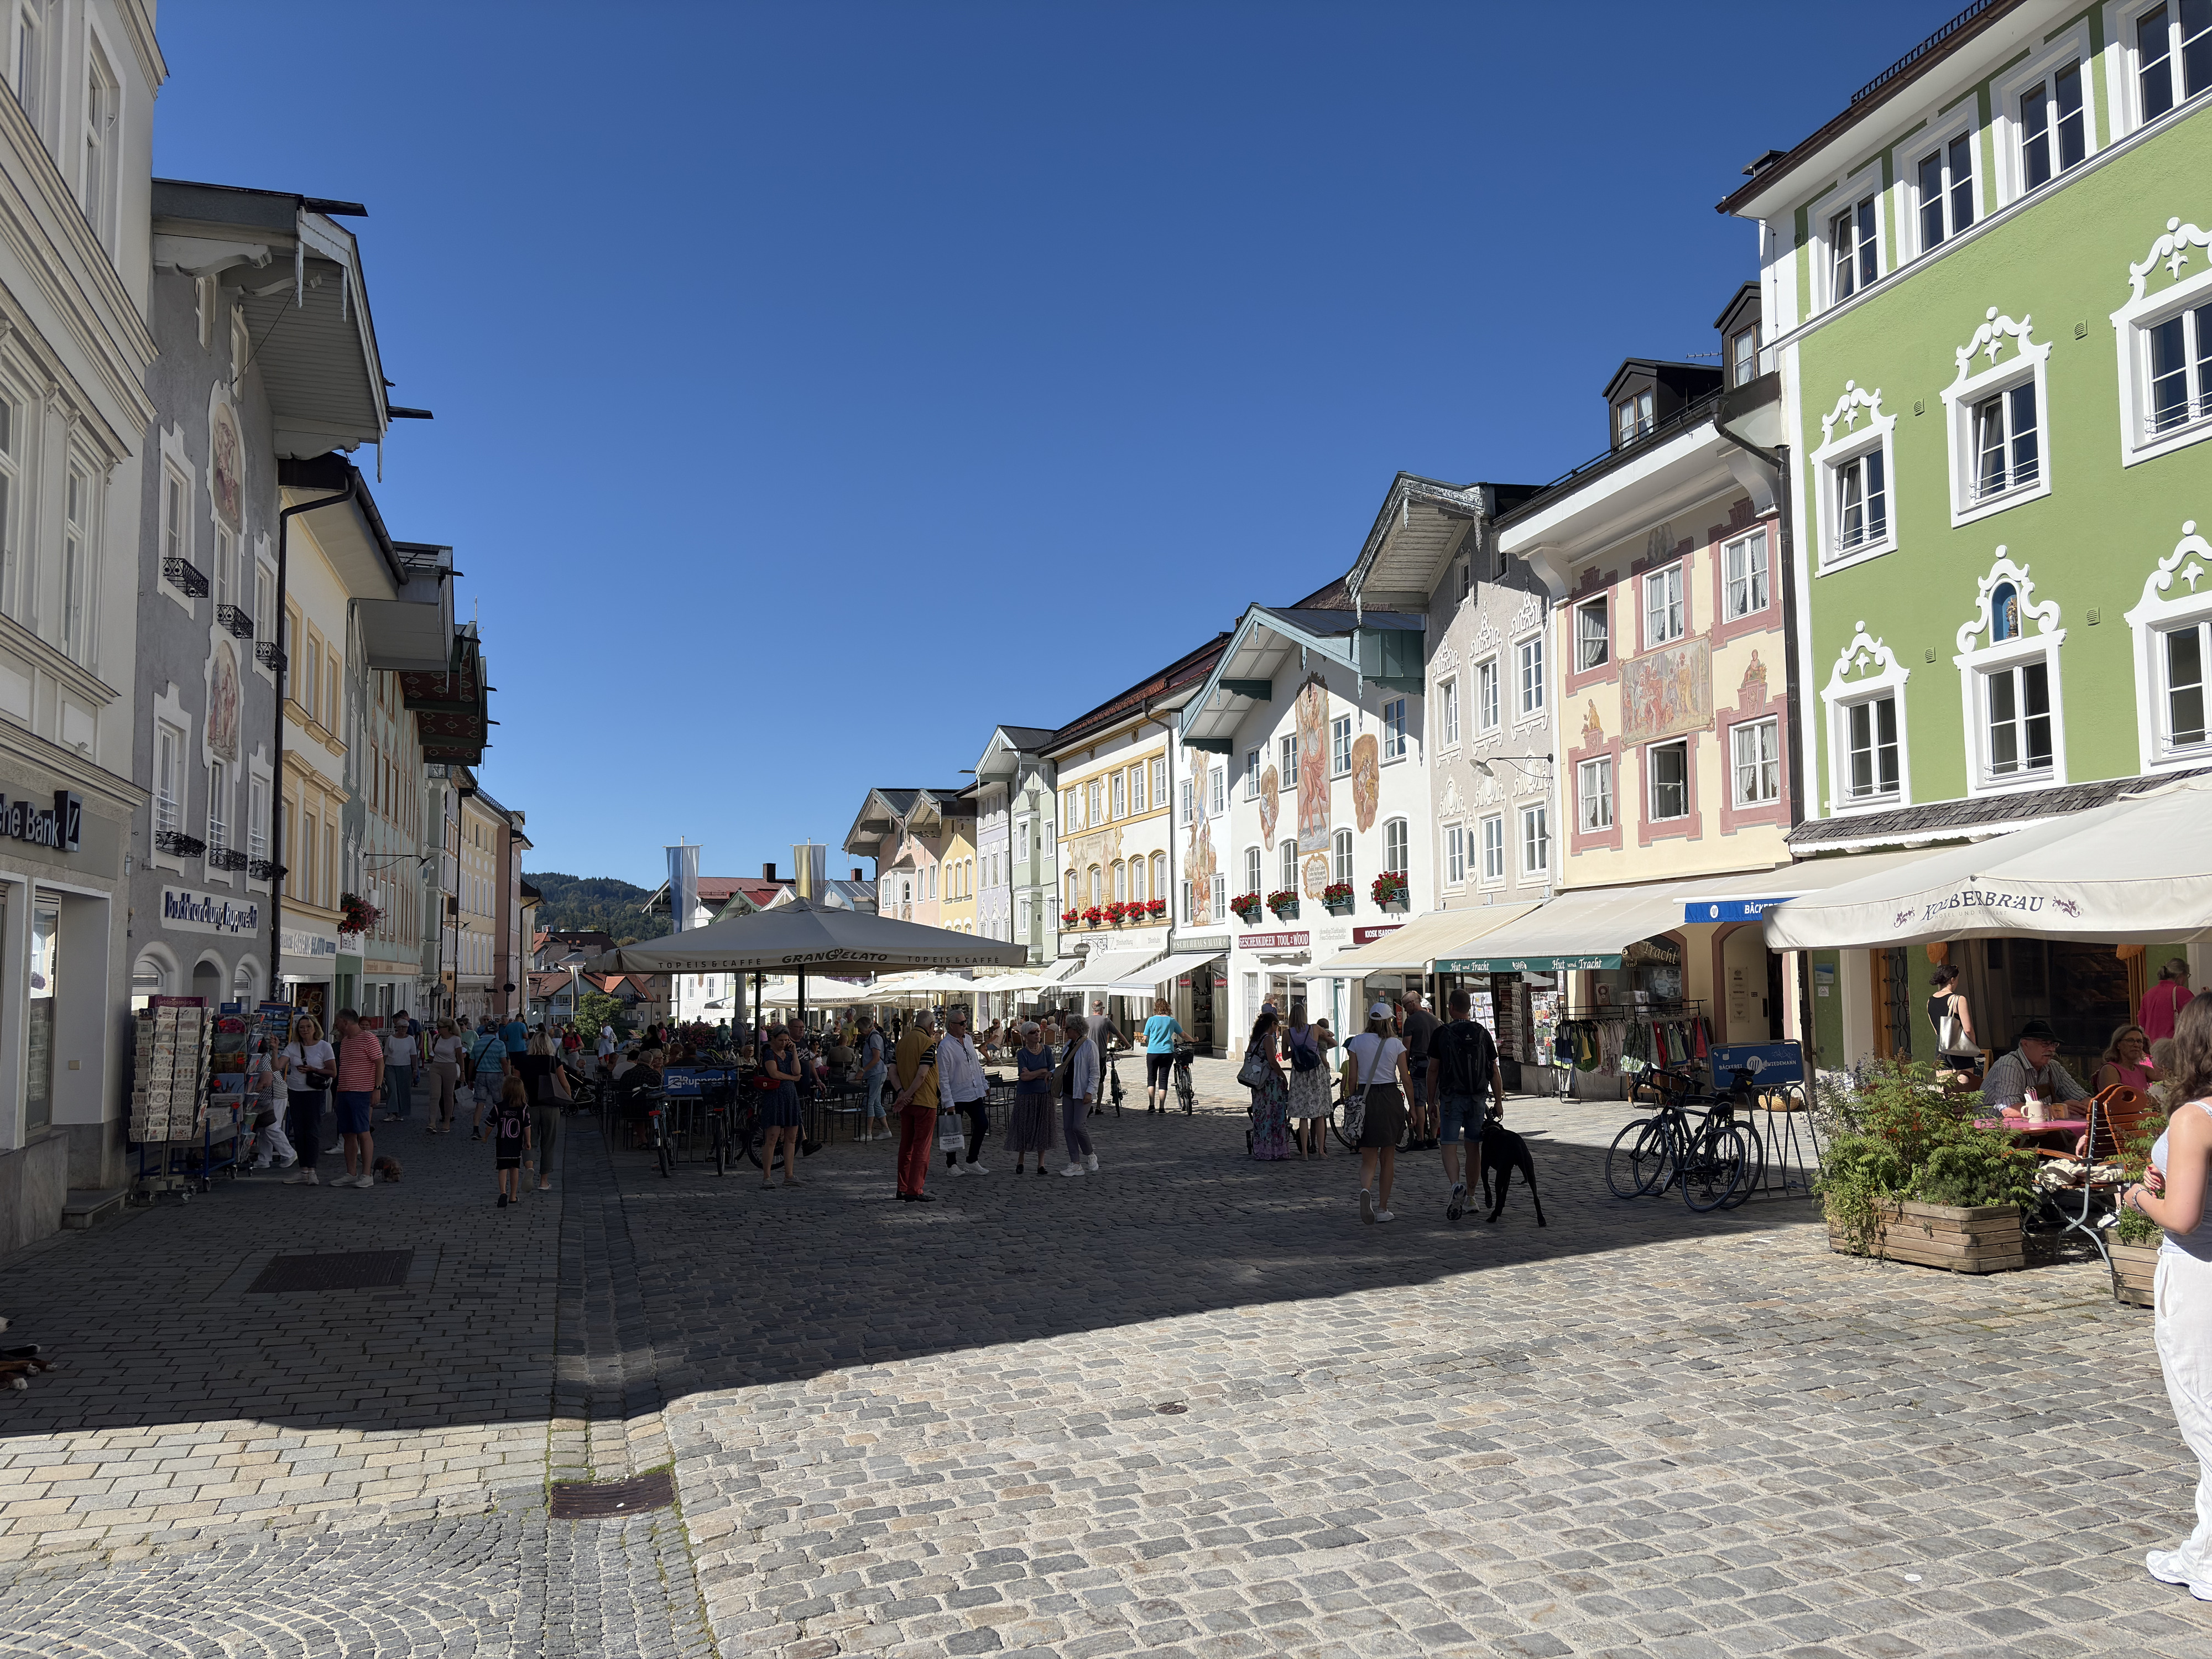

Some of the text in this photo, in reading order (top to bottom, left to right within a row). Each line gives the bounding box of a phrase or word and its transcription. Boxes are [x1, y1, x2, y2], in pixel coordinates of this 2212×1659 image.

[0, 793, 59, 847] he Bank
[166, 891, 258, 932] Buchhandlung Rupprecht
[1745, 902, 1780, 914] BÄCK
[1920, 890, 2044, 921] KOLBERBRÄU
[1365, 930, 1378, 938] KIOSK
[1176, 939, 1206, 948] SCHUHHAUS
[1208, 938, 1223, 947] MAYR
[1239, 935, 1275, 947] GESCHENKIDEEN
[782, 948, 888, 963] GRANGELATO
[1643, 941, 1677, 964] Tracht
[1449, 961, 1461, 971] Hut
[1471, 961, 1490, 971] Tracht
[1552, 958, 1565, 969] Hut
[1578, 957, 1602, 969] Tracht
[1625, 958, 1638, 968] und
[500, 1117, 520, 1138] 10
